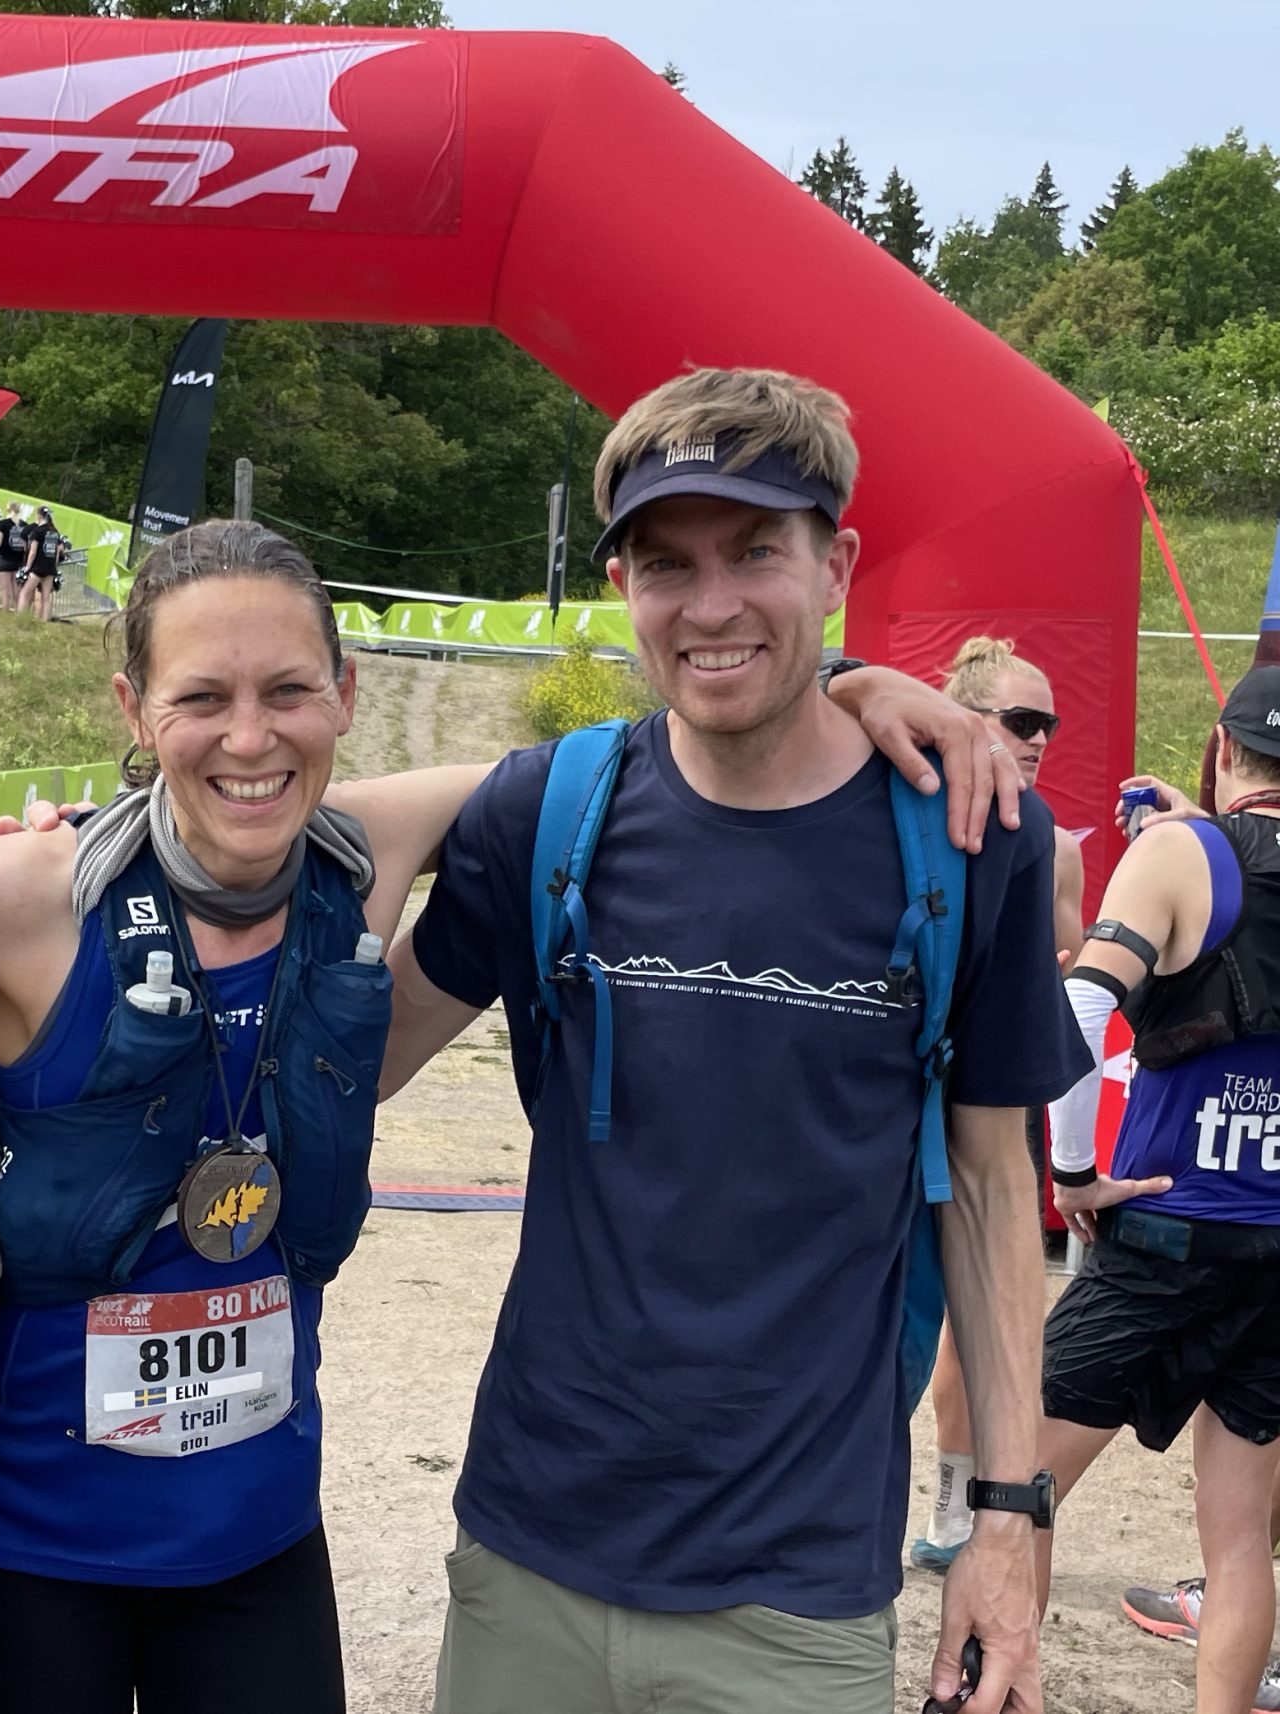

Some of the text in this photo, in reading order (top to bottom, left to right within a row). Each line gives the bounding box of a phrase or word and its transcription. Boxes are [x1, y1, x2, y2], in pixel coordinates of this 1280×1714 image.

[142, 519, 162, 532] that
[144, 506, 190, 526] Movement
[1224, 1072, 1272, 1093] TEAM
[1221, 1090, 1280, 1112] NORD
[1195, 1096, 1280, 1172] tra
[207, 1279, 289, 1321] 80 KM
[139, 1325, 247, 1383] 8101
[175, 1381, 208, 1401] ELIN
[180, 1398, 228, 1431] trail
[94, 1425, 162, 1442] ALTRA
[180, 1436, 209, 1452] 8101
